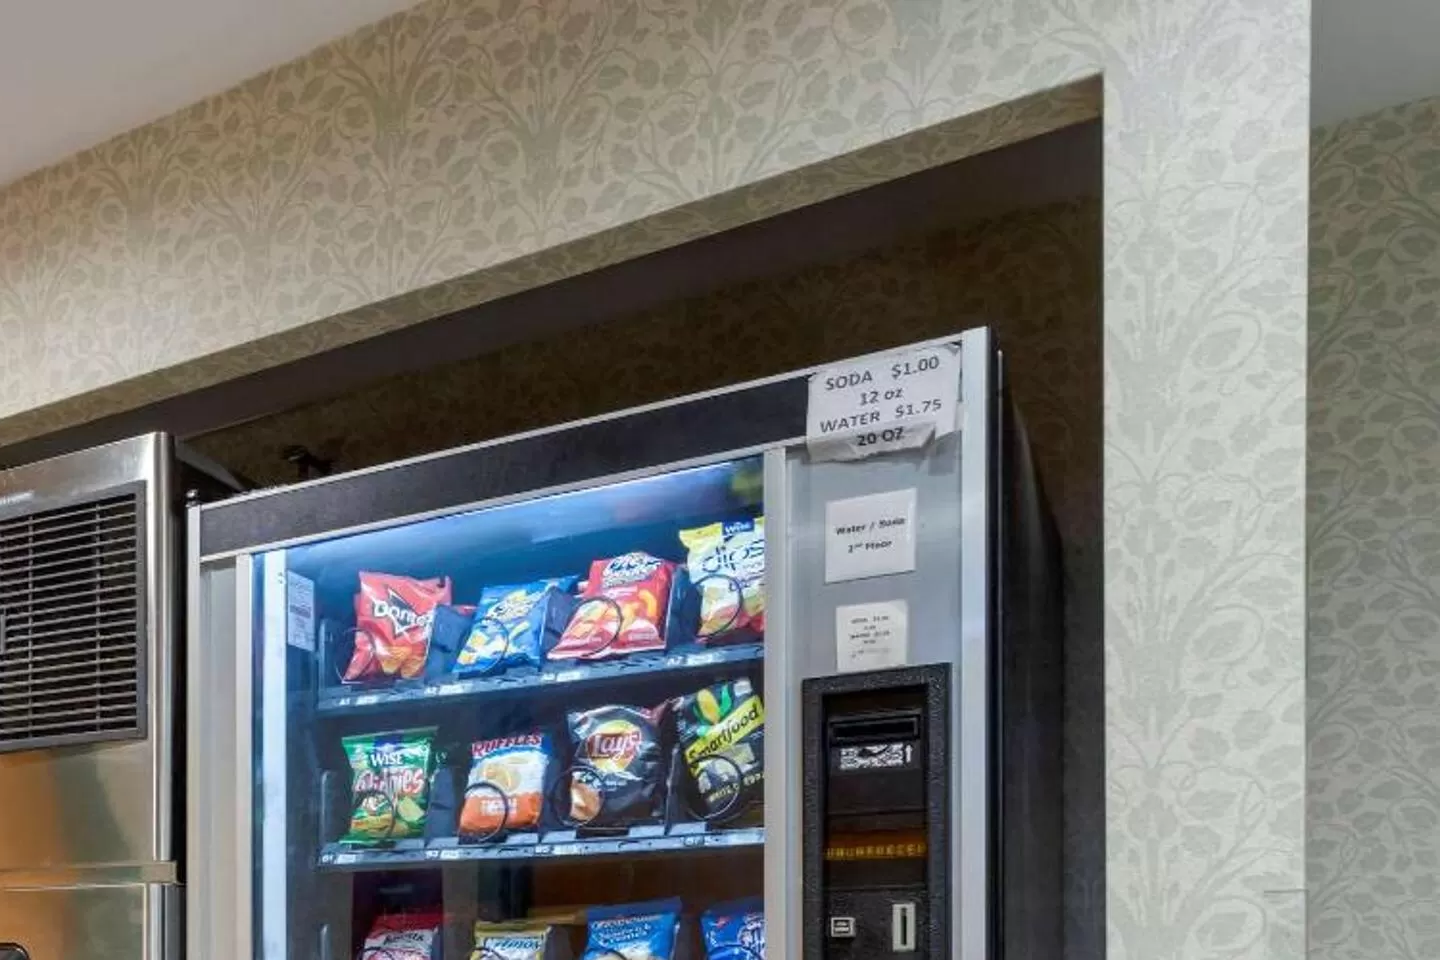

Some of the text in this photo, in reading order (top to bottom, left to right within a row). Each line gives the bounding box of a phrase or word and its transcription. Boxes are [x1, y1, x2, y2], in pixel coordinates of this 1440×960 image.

[825, 356, 940, 391] SODA $1.00
[860, 391, 879, 405] 12
[820, 399, 942, 433] WATER $1.75
[856, 433, 877, 447] 20
[836, 525, 866, 535] Water
